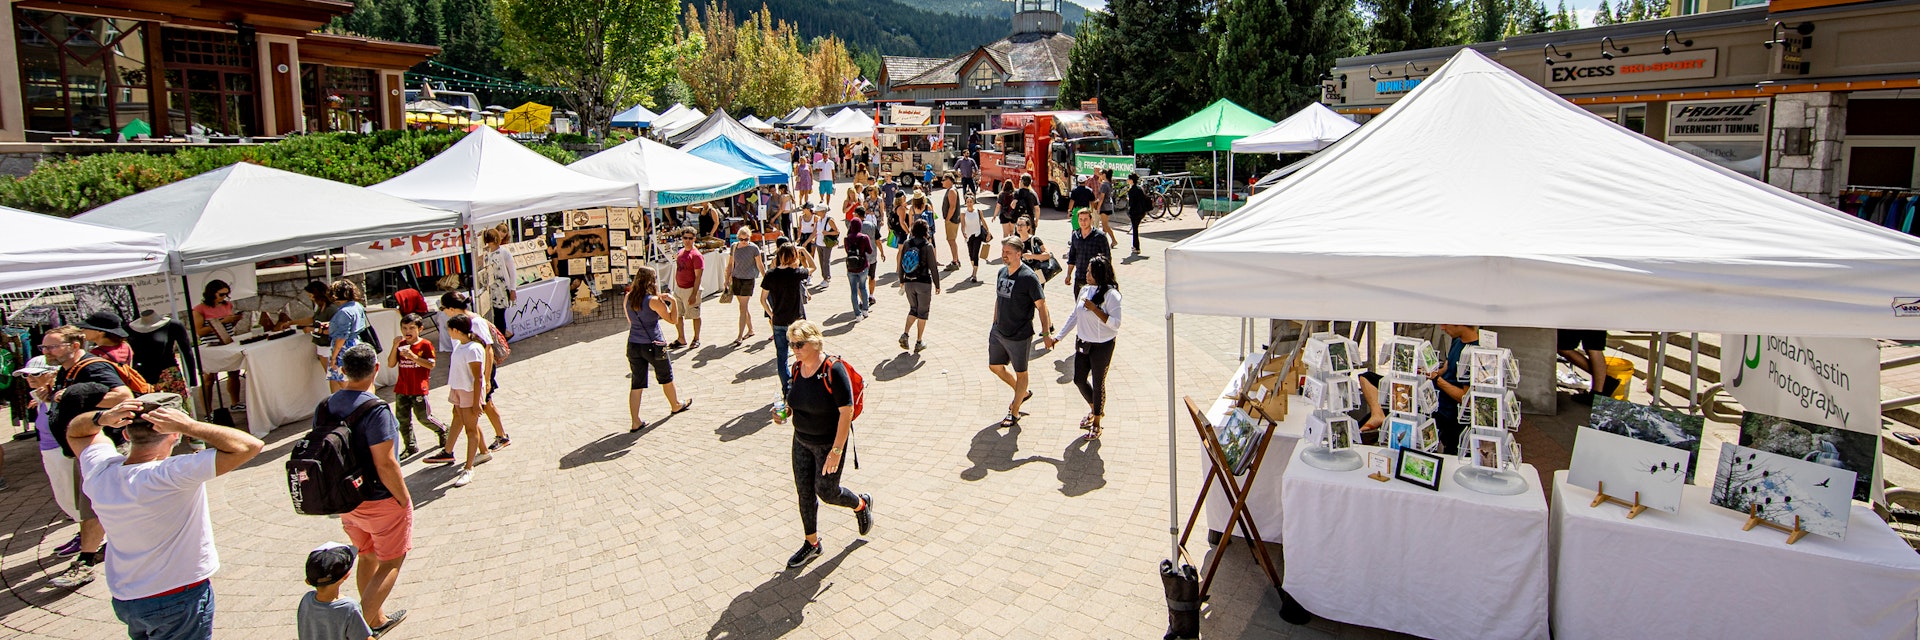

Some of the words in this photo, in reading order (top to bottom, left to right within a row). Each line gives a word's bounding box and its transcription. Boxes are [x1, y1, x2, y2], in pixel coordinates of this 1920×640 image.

[1552, 65, 1615, 82] EXCESS
[1326, 84, 1337, 93] EX
[1376, 80, 1403, 92] ALPINE
[1676, 103, 1760, 118] PROFILE
[1675, 124, 1722, 134] OVERNIGHT
[1725, 123, 1759, 133] TUNING
[1108, 162, 1134, 173] PARKING
[662, 192, 698, 204] Massage
[511, 319, 531, 335] PINE
[534, 309, 561, 327] PRINTS
[1768, 360, 1850, 428] Photography
